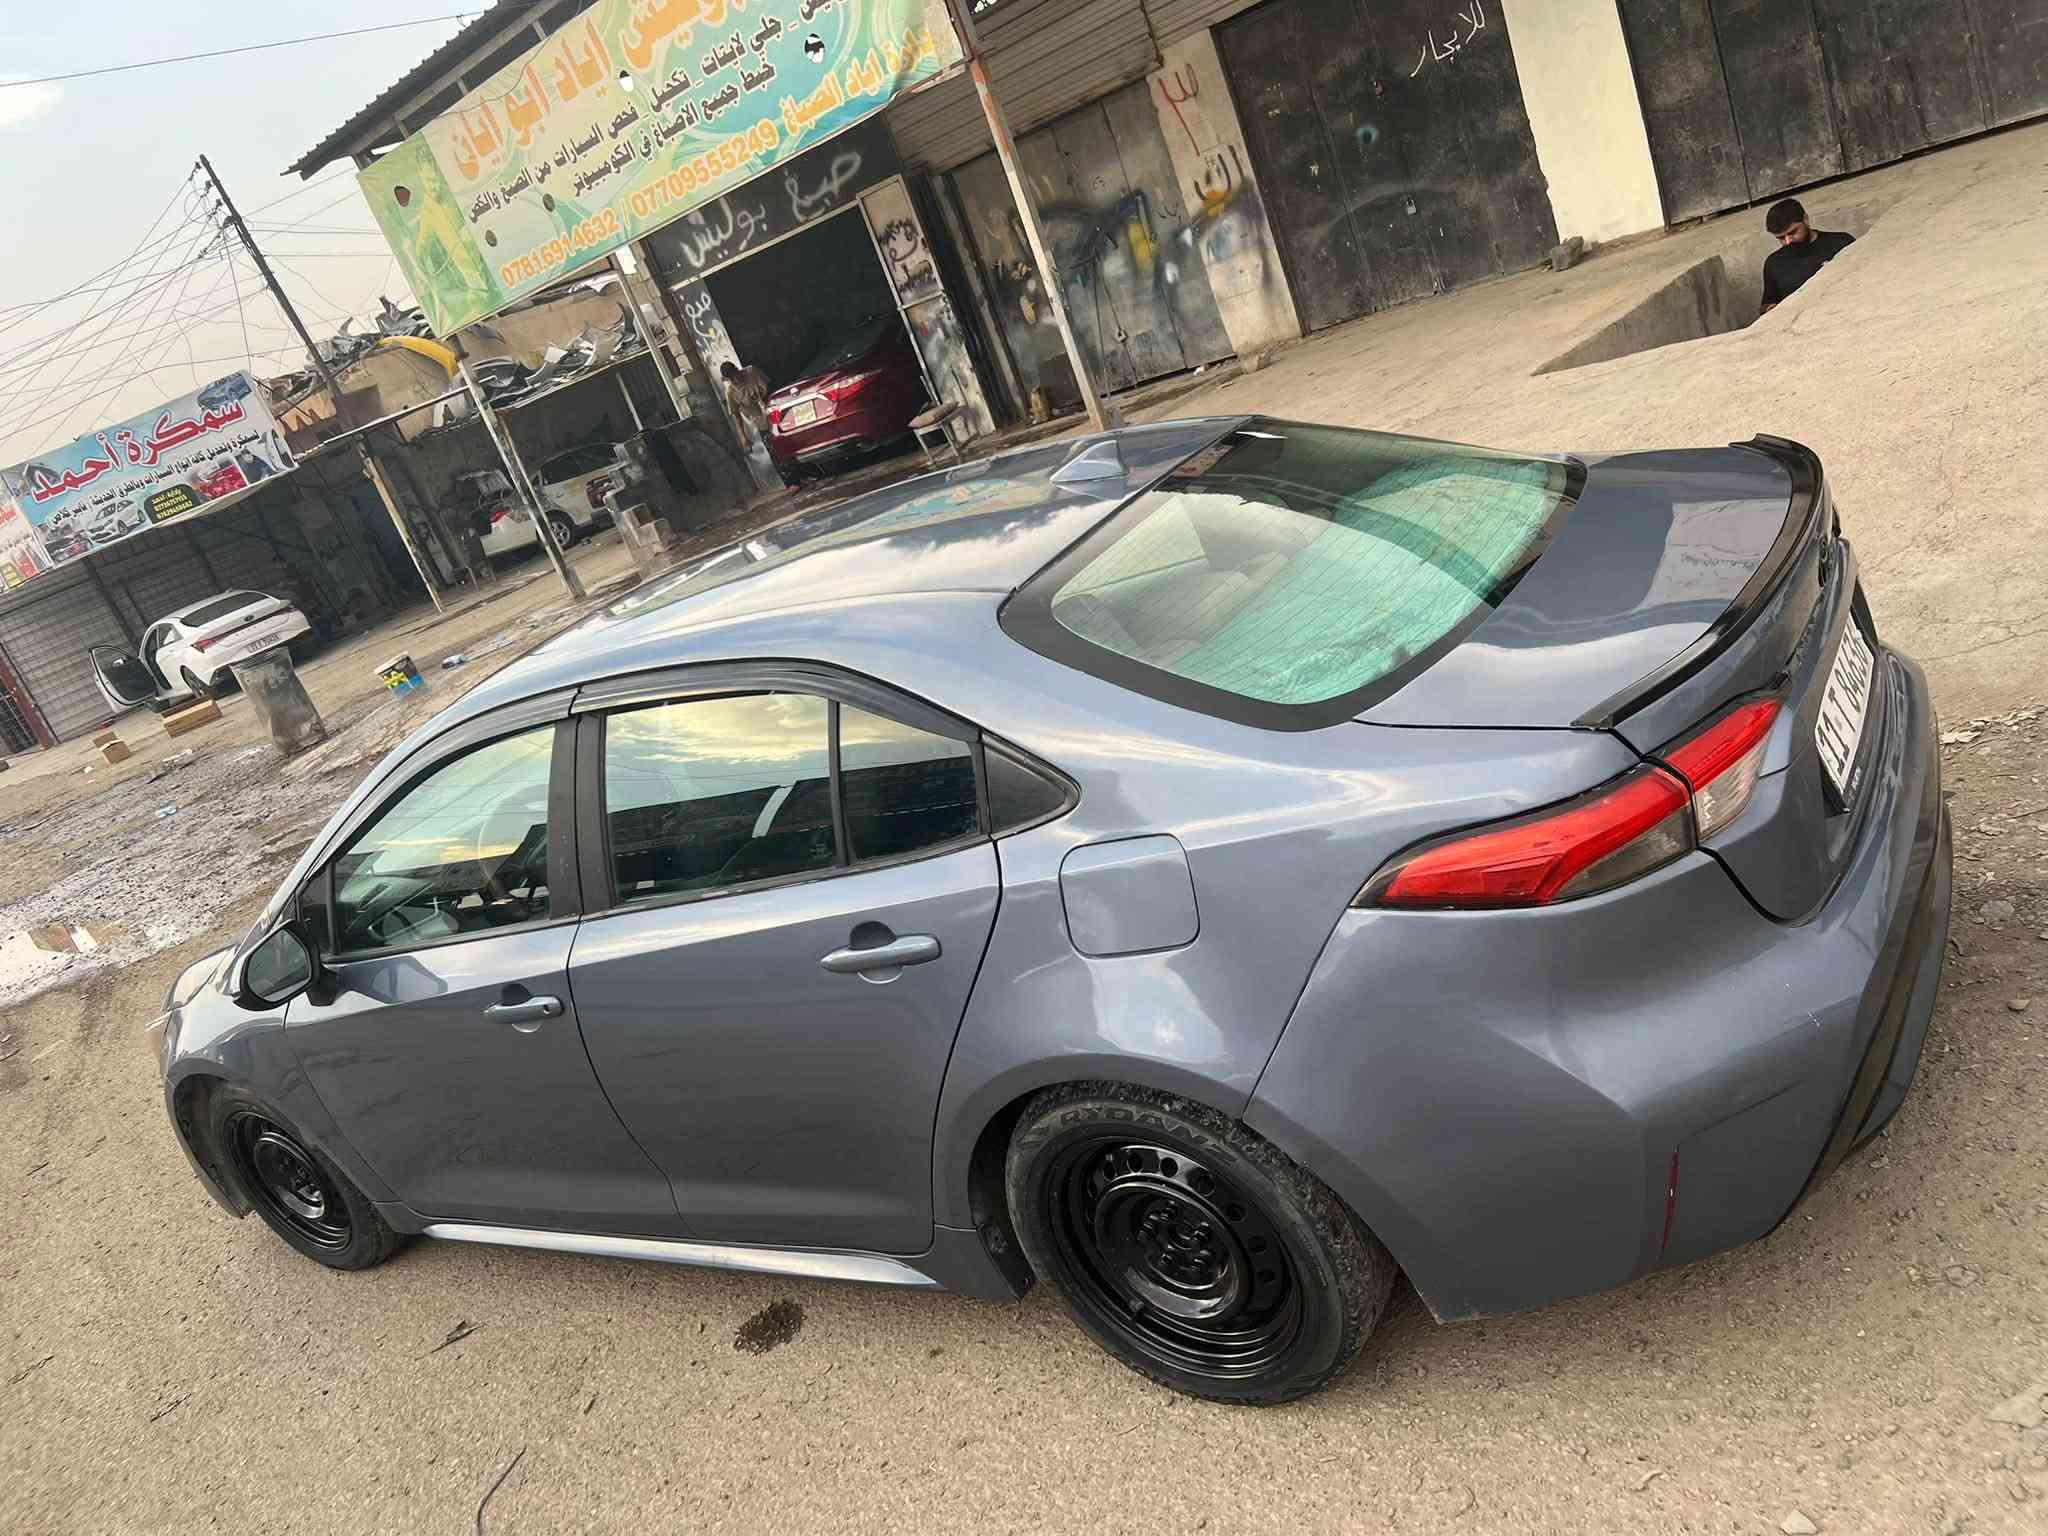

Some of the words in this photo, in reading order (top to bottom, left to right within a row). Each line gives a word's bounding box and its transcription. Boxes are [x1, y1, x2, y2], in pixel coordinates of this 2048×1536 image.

[608, 101, 640, 140] فحص
[703, 83, 739, 120] جميع
[553, 122, 605, 167] السيارات
[639, 130, 652, 160] في
[535, 158, 552, 183] من
[117, 399, 245, 466] سمكرة
[32, 432, 121, 502] أحمد
[1818, 712, 1850, 776] 11
